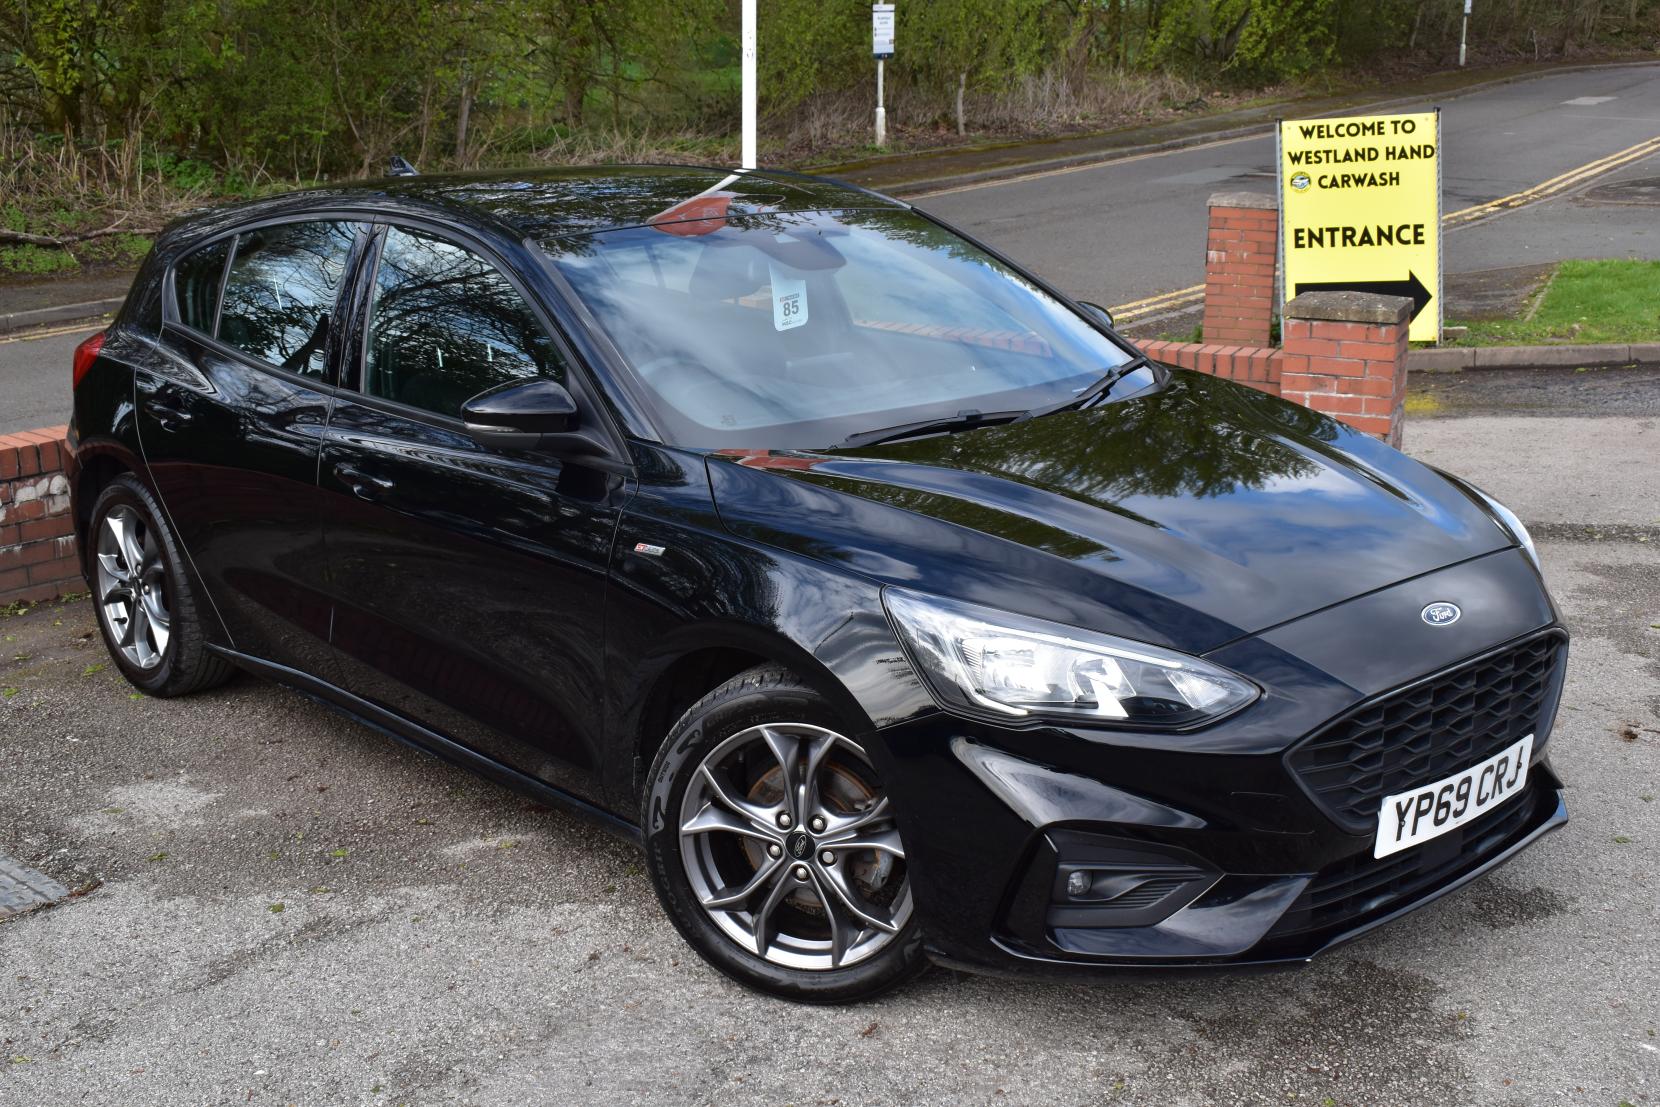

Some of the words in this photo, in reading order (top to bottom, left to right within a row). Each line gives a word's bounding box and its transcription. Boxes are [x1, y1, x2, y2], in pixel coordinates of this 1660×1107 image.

[1299, 121, 1385, 139] WELCOME
[1391, 119, 1416, 135] TO
[1288, 147, 1379, 165] WESTLAND
[1385, 144, 1435, 160] HAND
[1318, 172, 1400, 189] CARWASH
[1294, 224, 1425, 249] ENTRANCE
[783, 300, 799, 317] 85
[1395, 775, 1472, 842] YP69
[1476, 745, 1524, 807] CRJ
